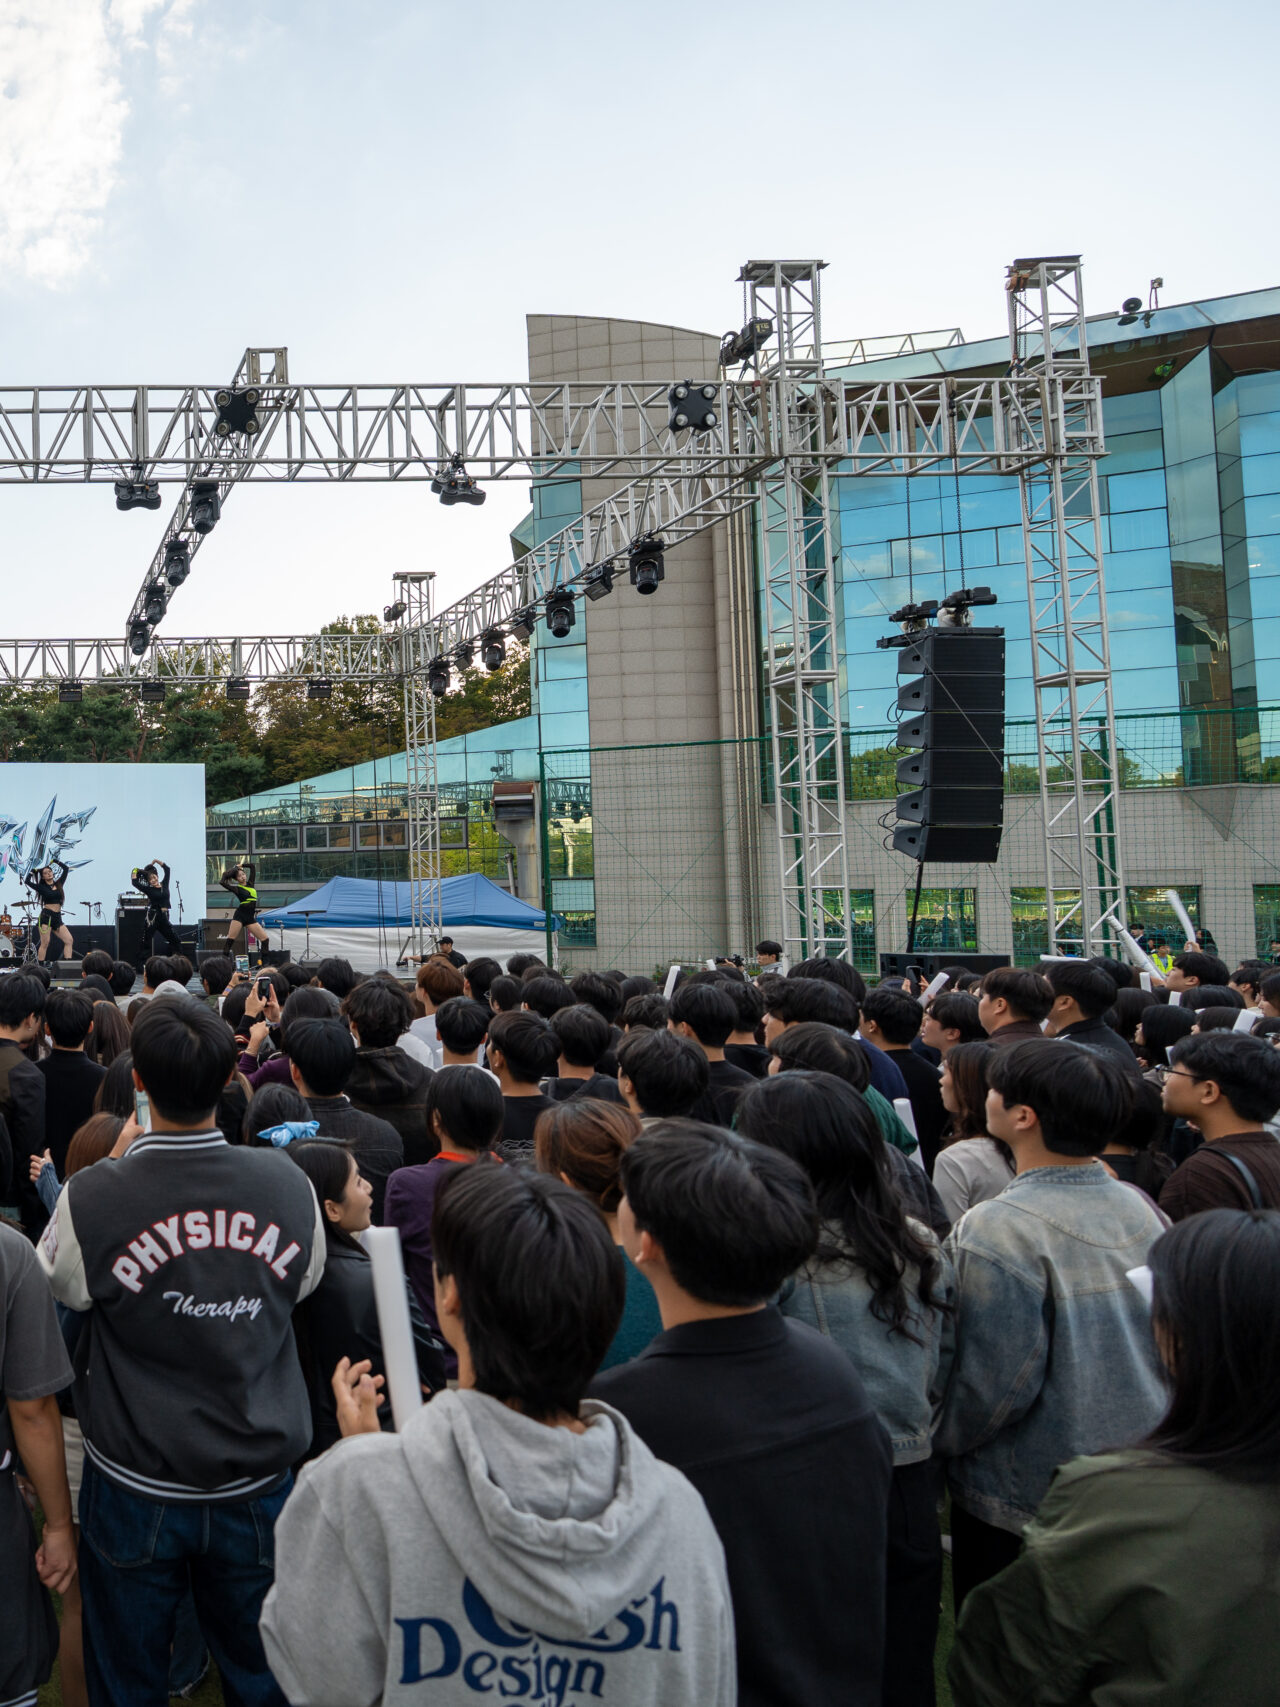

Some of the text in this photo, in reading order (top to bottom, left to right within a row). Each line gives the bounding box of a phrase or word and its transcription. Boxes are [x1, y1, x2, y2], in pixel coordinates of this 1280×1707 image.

[111, 1209, 301, 1294] PHYSICAL
[162, 1291, 263, 1323] Therapy
[393, 1617, 604, 1707] Design
